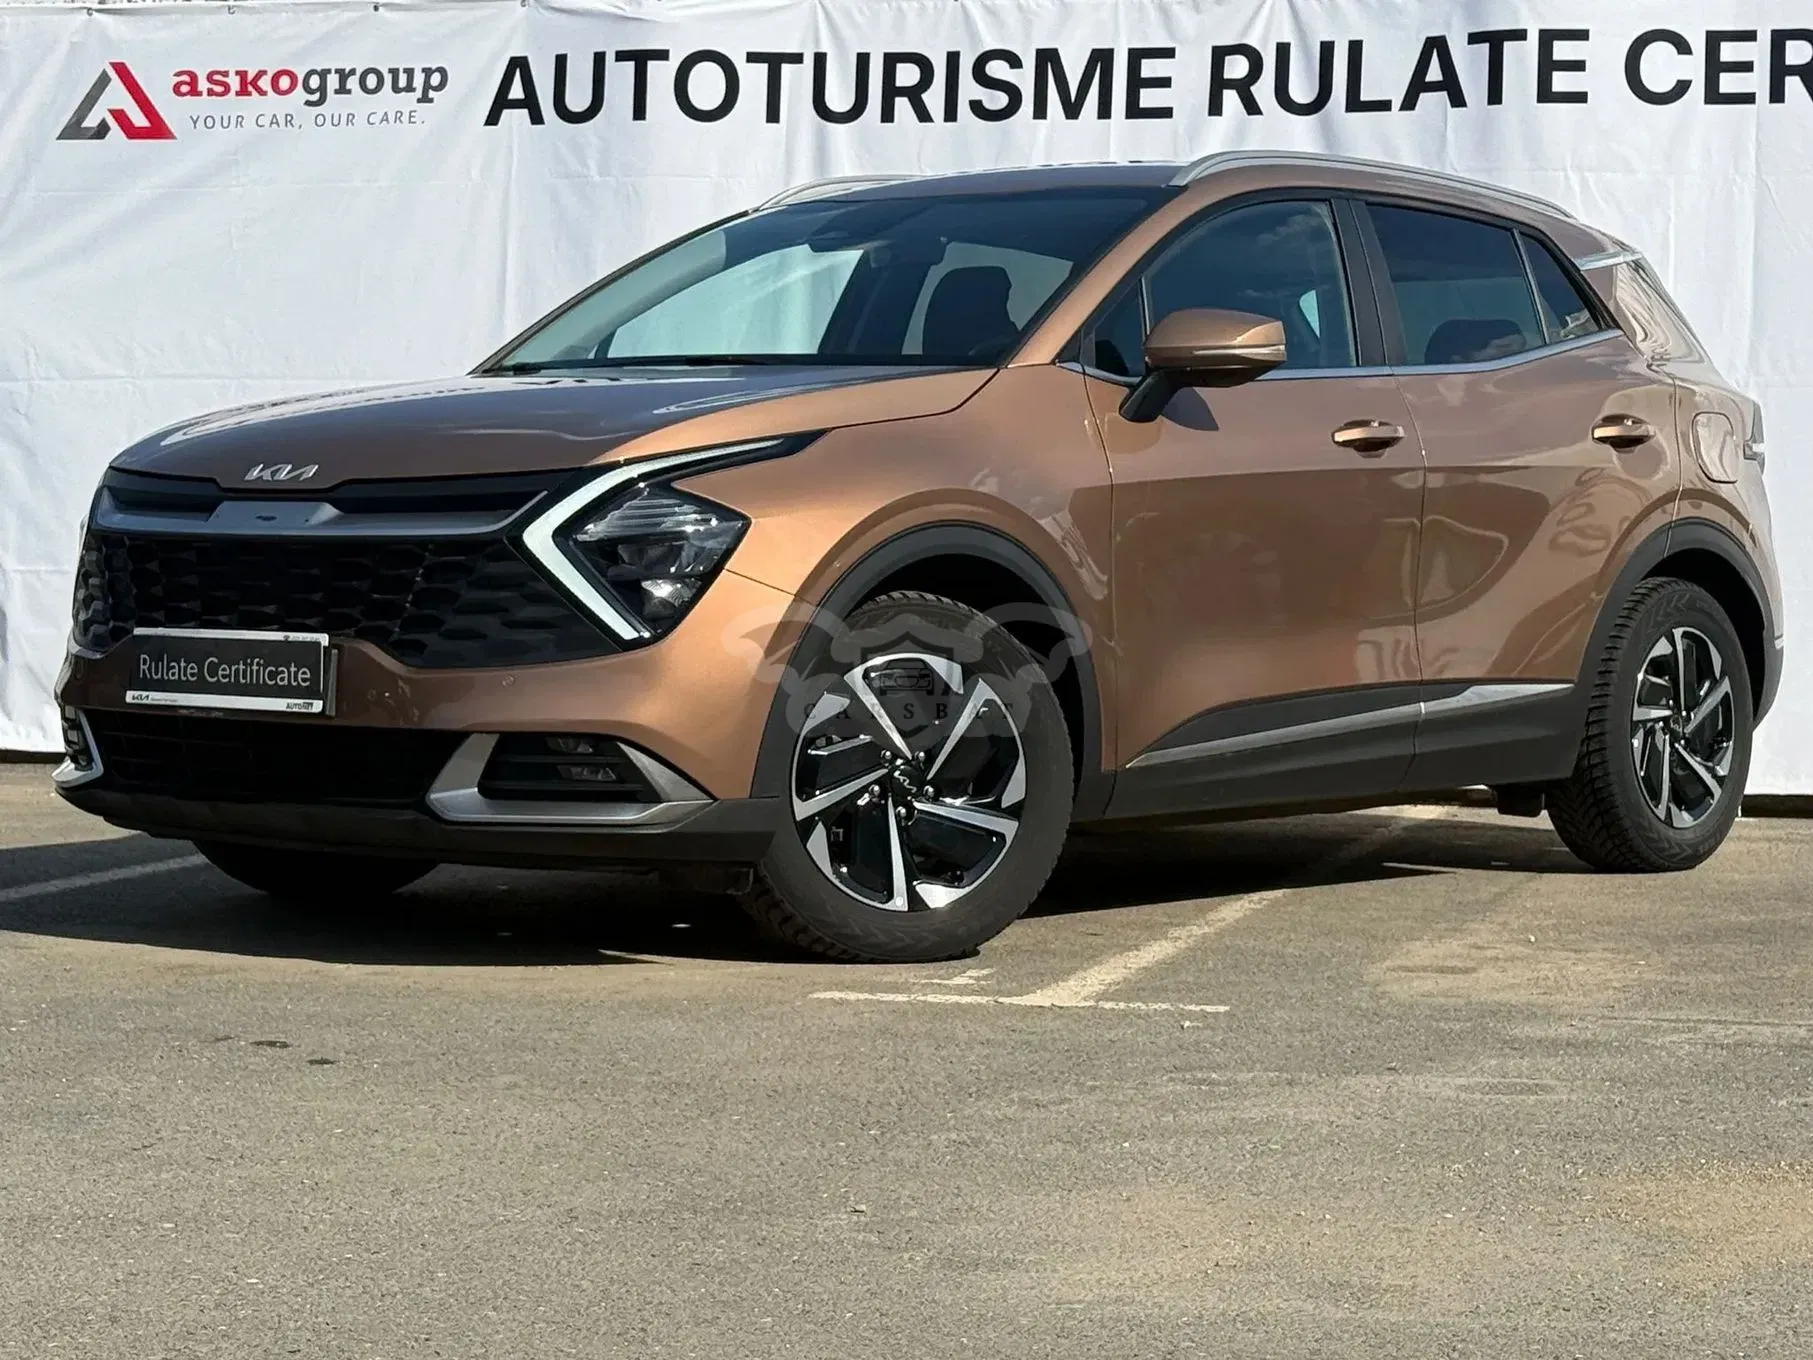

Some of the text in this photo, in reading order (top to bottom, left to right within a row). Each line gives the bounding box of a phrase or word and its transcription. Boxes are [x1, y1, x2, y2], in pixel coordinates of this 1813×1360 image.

[171, 65, 449, 107] askogroup
[483, 28, 1813, 127] AUTOTURISME RULATE CER
[189, 110, 426, 130] YOUR CAR, OUR CARE.
[139, 653, 311, 687] Rulate Certificate
